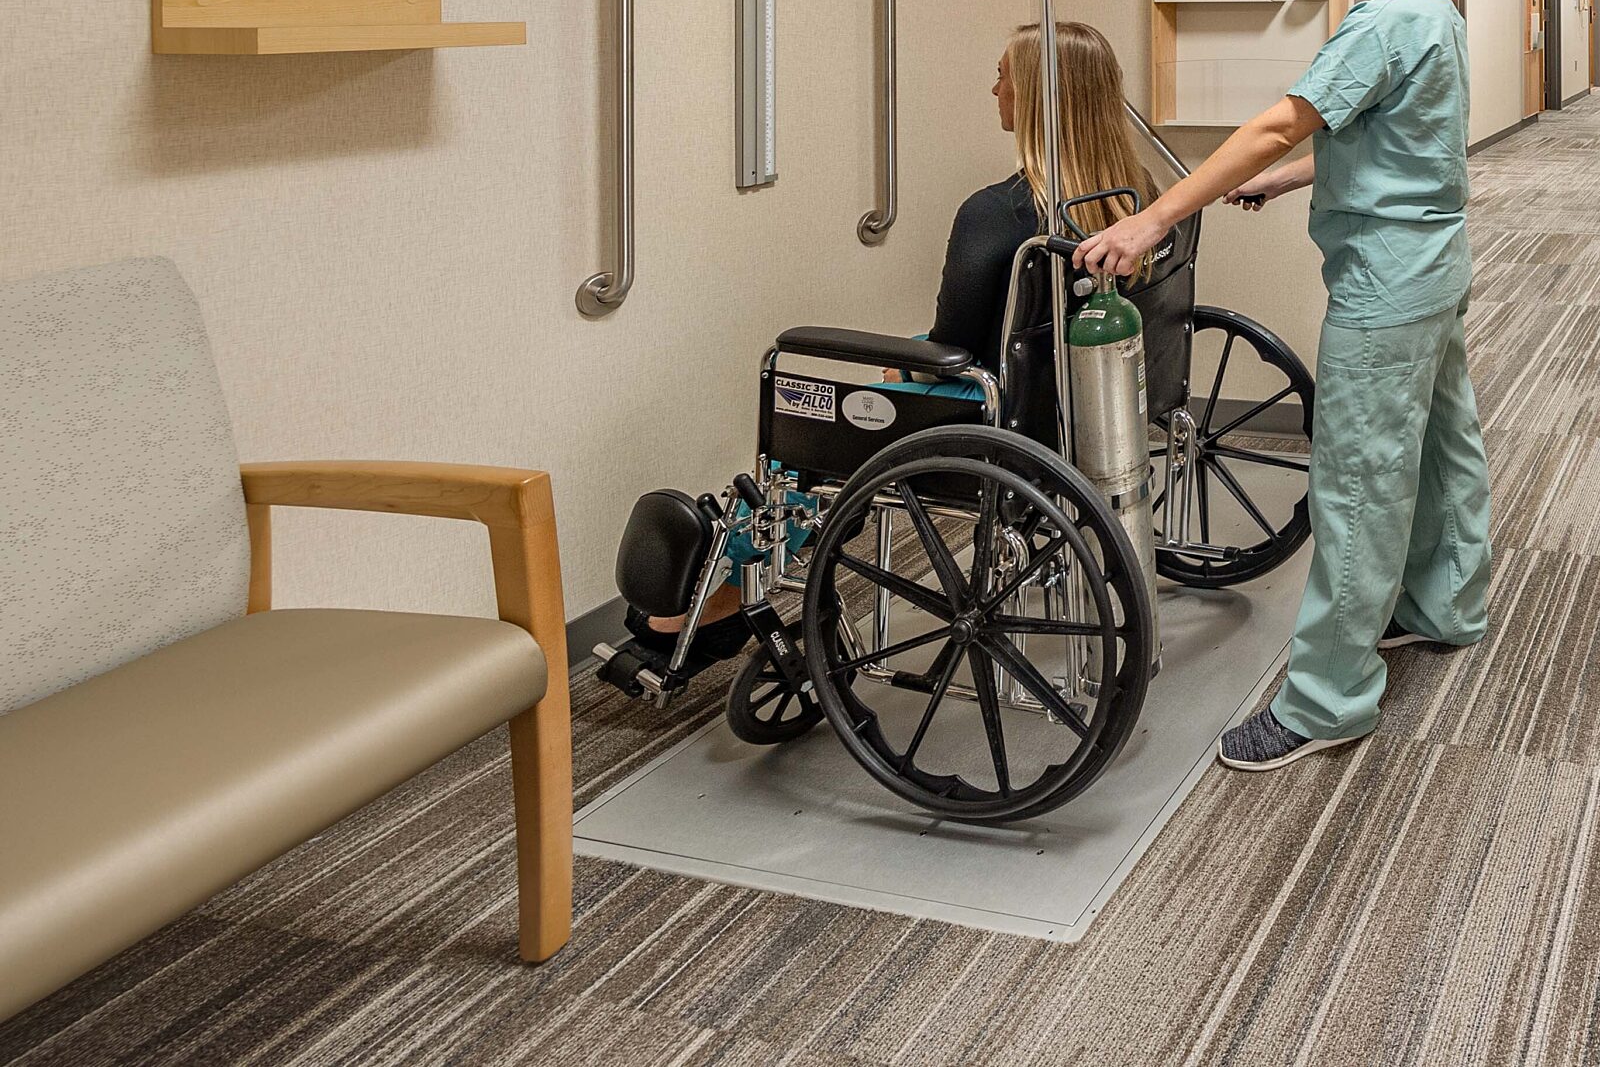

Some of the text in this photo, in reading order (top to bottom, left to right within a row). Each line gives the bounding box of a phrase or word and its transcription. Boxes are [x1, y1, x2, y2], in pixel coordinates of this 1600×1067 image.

[775, 379, 834, 394] CLASSIC 300
[791, 394, 833, 410] by ALCO
[770, 631, 788, 655] CLASSIC
